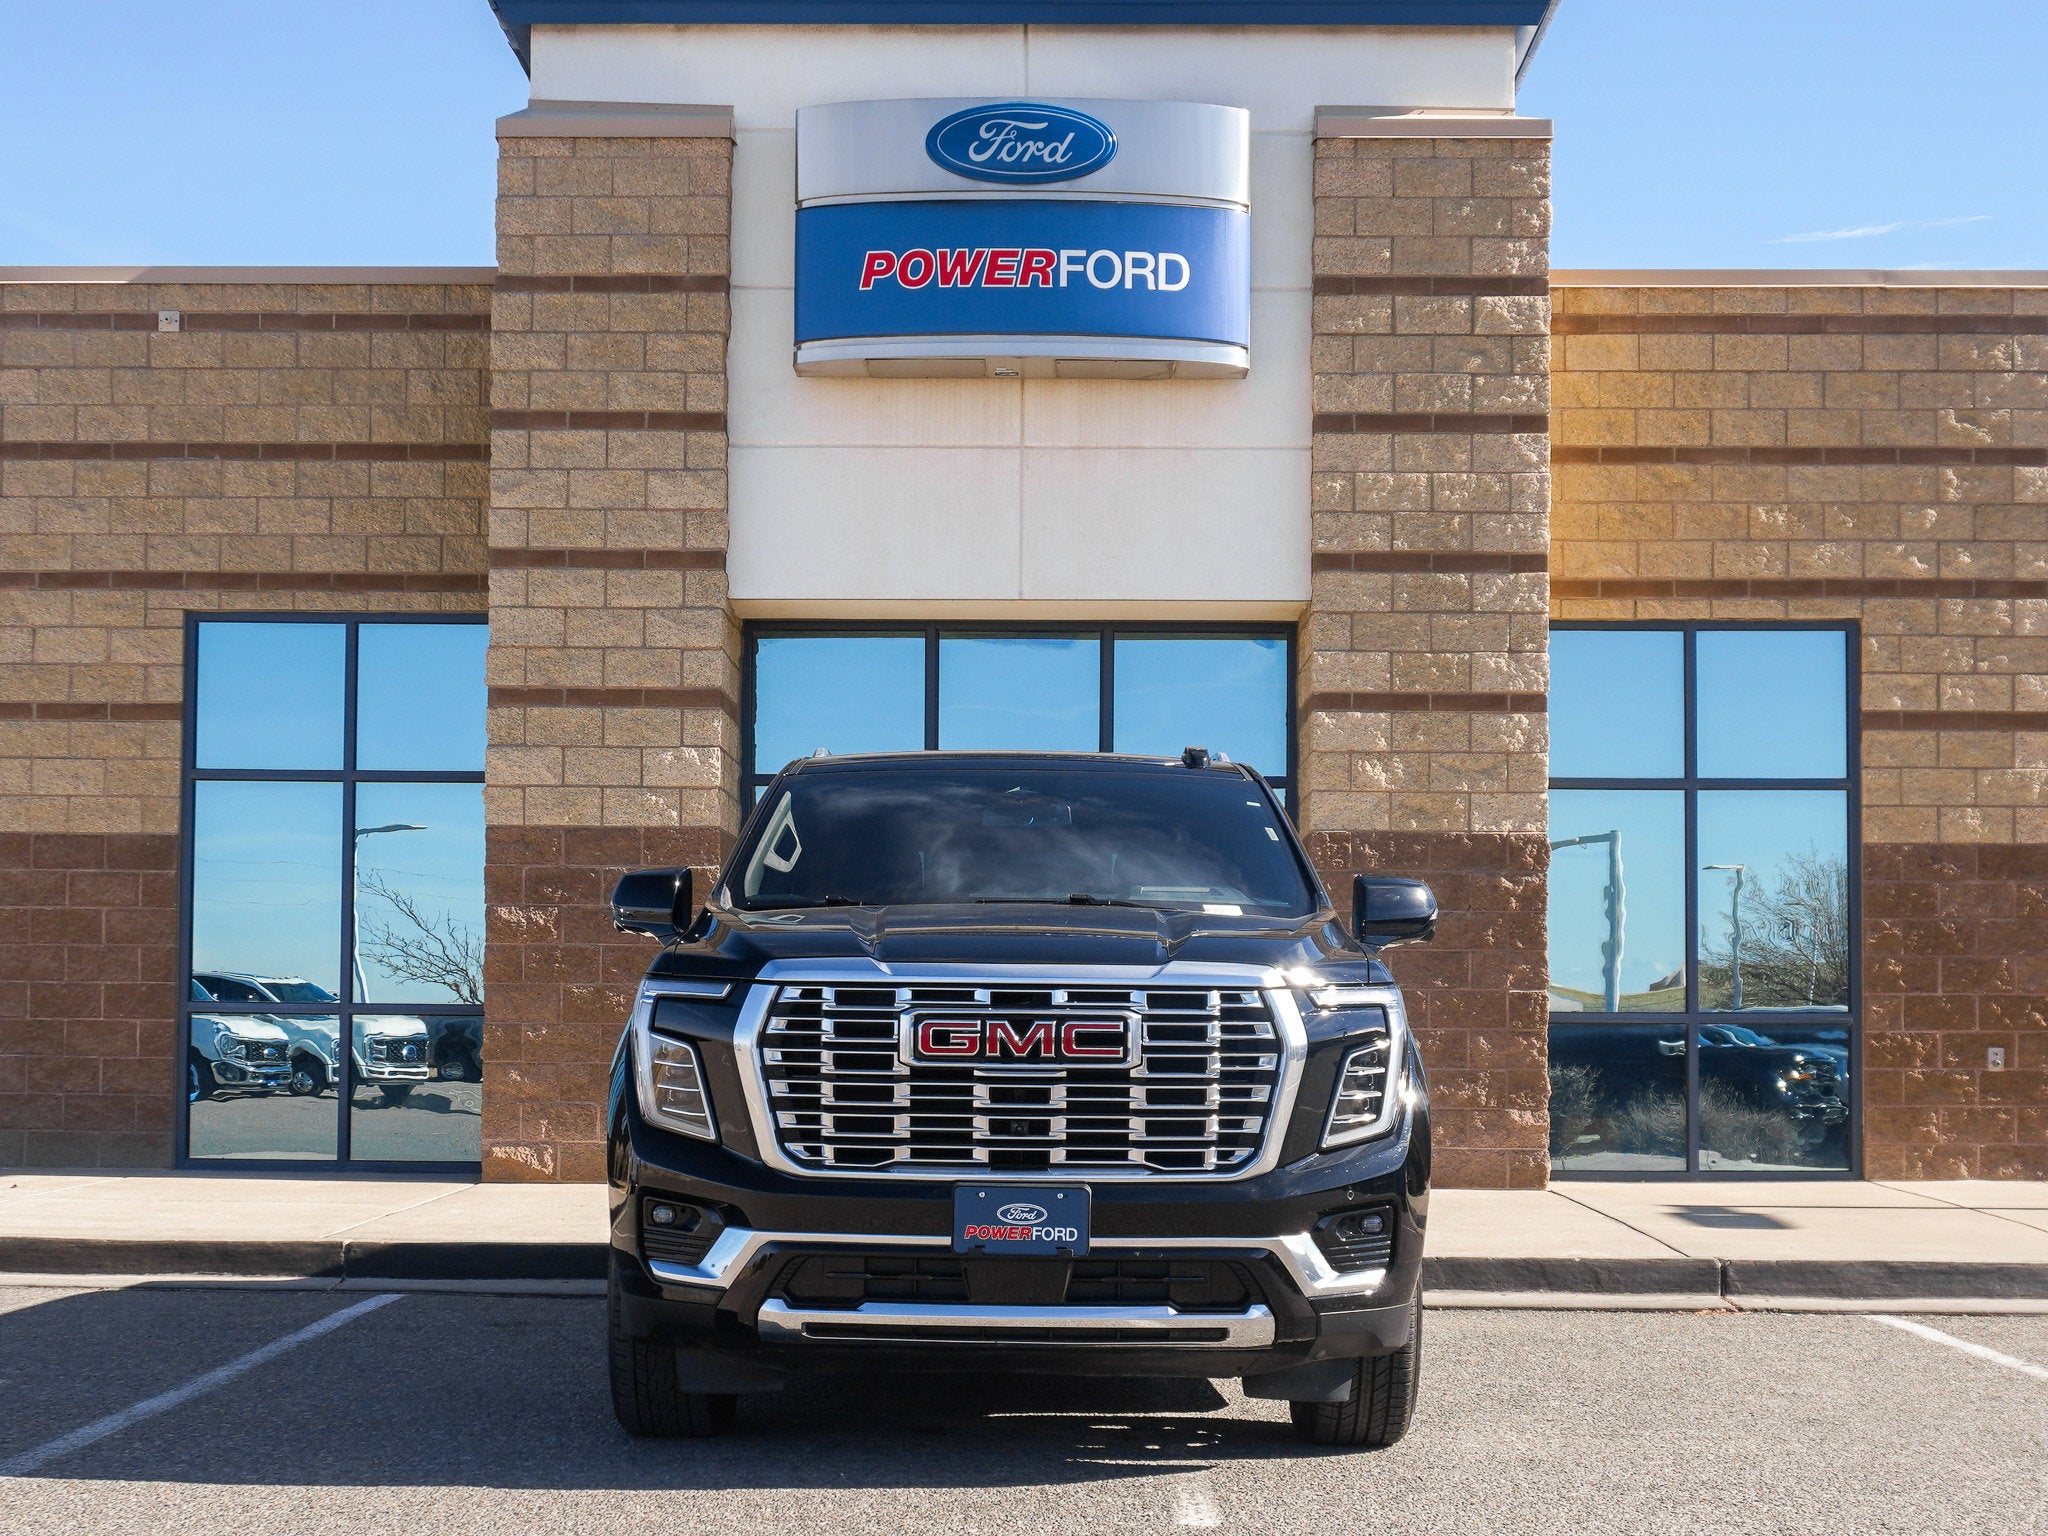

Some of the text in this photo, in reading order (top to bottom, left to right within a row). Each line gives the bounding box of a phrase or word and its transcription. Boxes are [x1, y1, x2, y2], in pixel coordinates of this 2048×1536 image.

[968, 119, 1075, 164] Ford
[918, 1020, 1124, 1057] GMC
[1007, 1208, 1036, 1220] Ford
